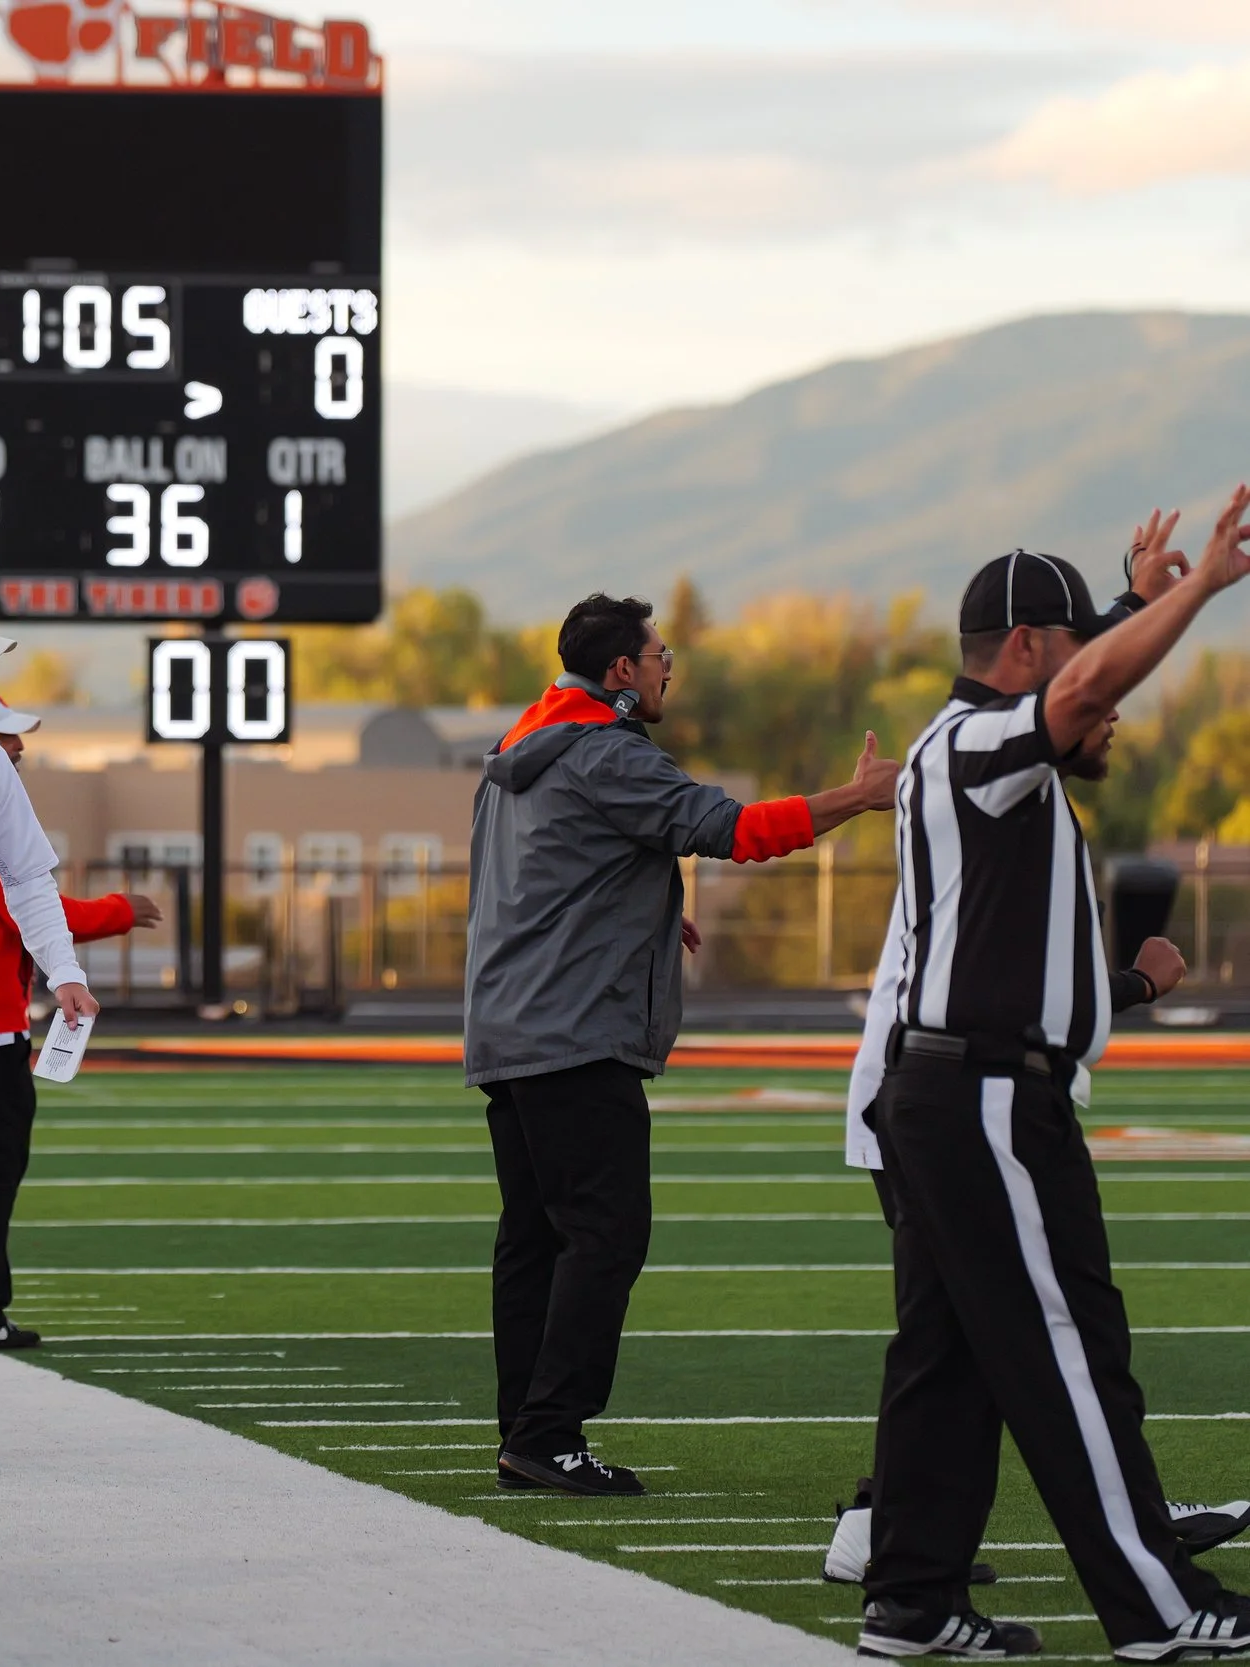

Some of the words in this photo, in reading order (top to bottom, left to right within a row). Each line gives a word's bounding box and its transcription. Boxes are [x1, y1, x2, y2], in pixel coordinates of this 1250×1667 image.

[136, 16, 371, 82] FIELD
[243, 288, 378, 335] GUESTS
[314, 335, 363, 419] 0
[83, 435, 173, 483] BALL
[174, 435, 227, 484] ON
[267, 436, 346, 484] QTR
[106, 483, 209, 566] 36
[284, 489, 302, 563] 1
[152, 639, 285, 739] 00
